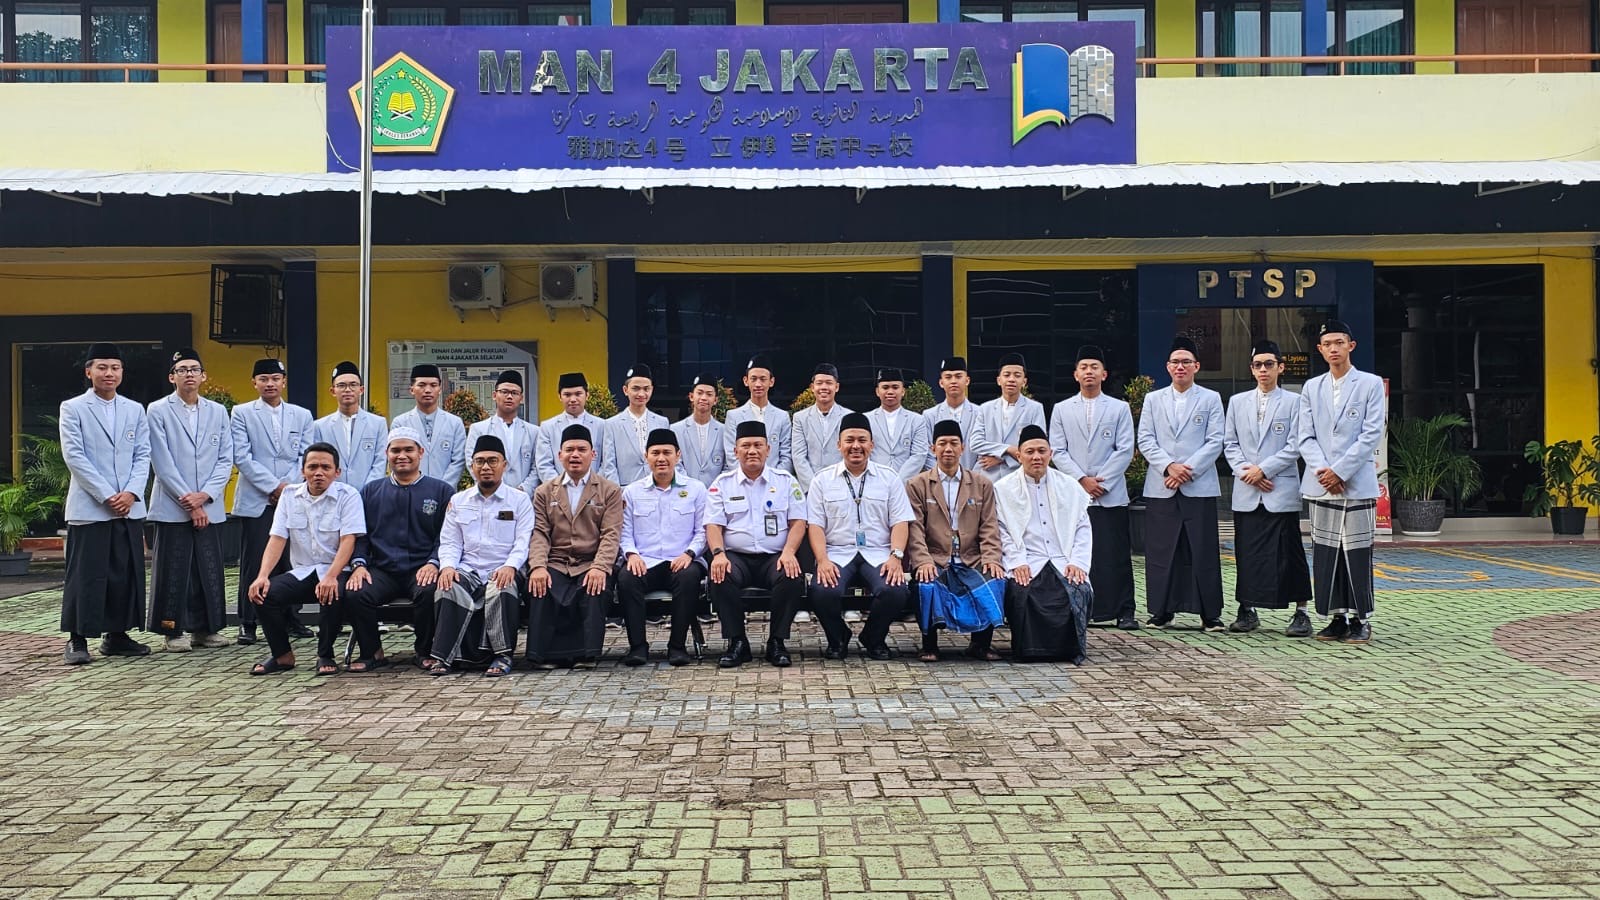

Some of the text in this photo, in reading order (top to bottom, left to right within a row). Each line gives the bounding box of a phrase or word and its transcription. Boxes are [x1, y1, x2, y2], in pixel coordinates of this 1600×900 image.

[478, 46, 990, 93] MAN 4 JAKARTA
[869, 96, 925, 125] المدرسة
[1197, 268, 1318, 299] PTSP
